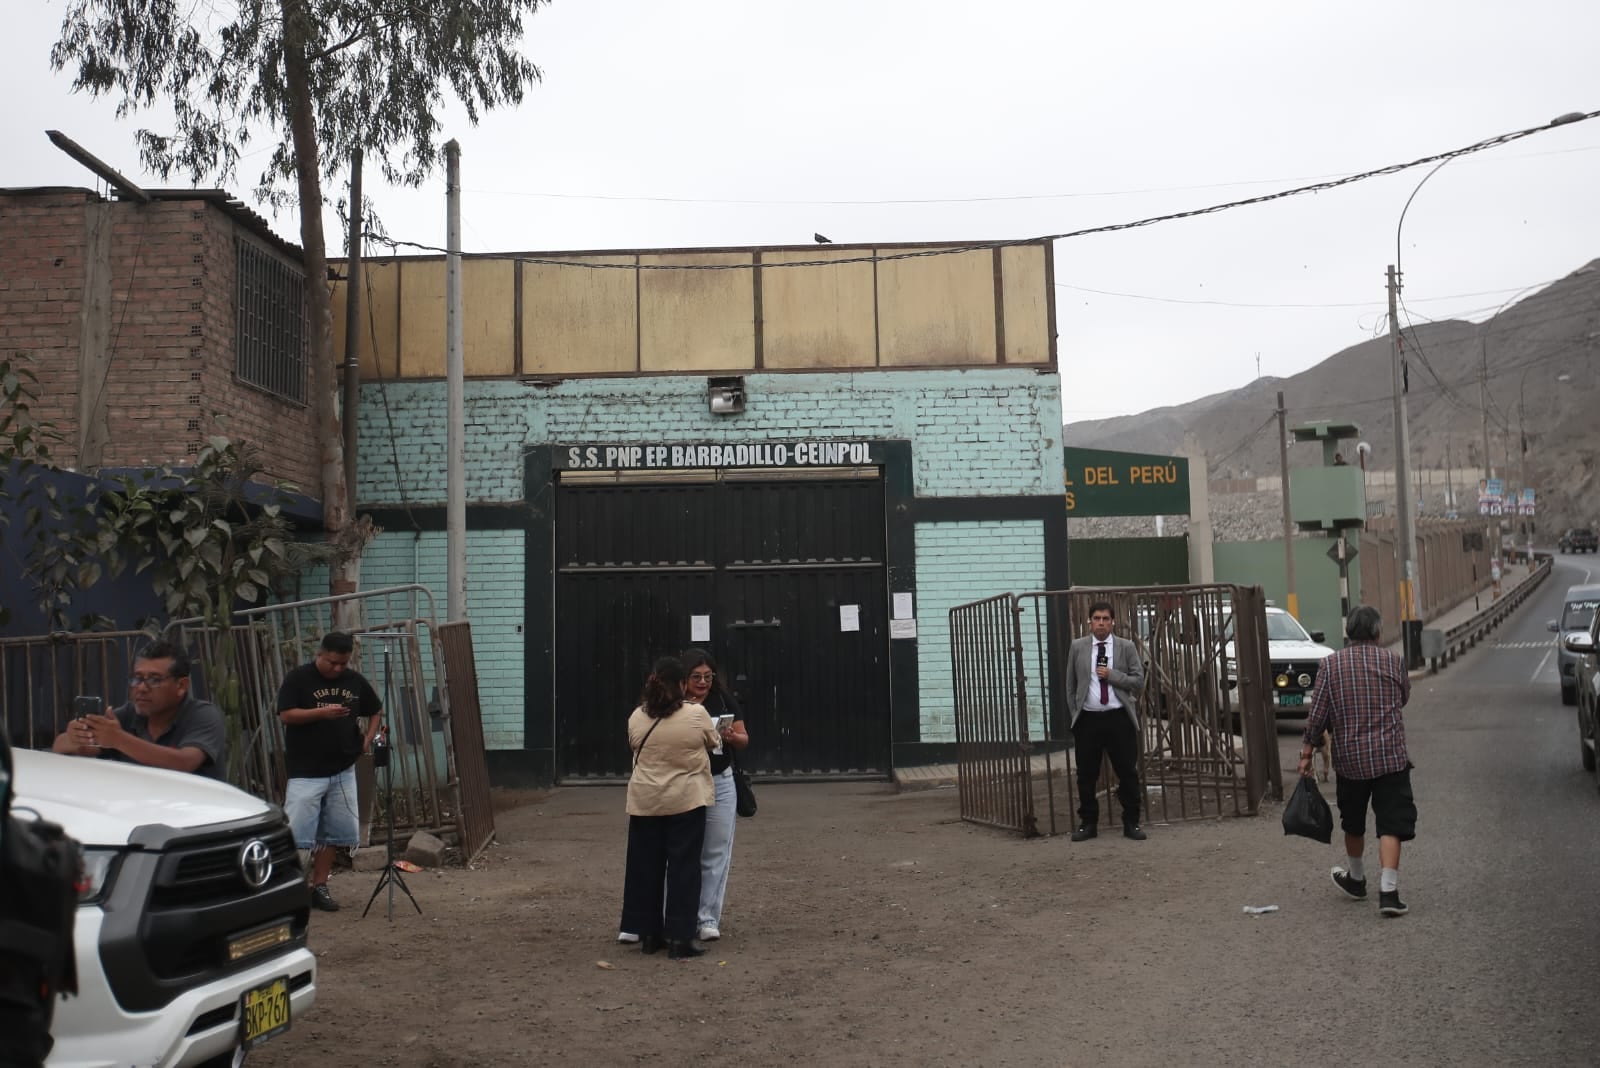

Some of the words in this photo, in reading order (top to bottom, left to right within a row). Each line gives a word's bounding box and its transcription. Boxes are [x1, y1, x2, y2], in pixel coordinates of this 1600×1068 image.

[568, 446, 602, 468] S.S.
[1085, 466, 1119, 485] DEL
[1130, 460, 1177, 485] PERÚ
[313, 689, 330, 700] FEAR
[331, 688, 340, 696] OF
